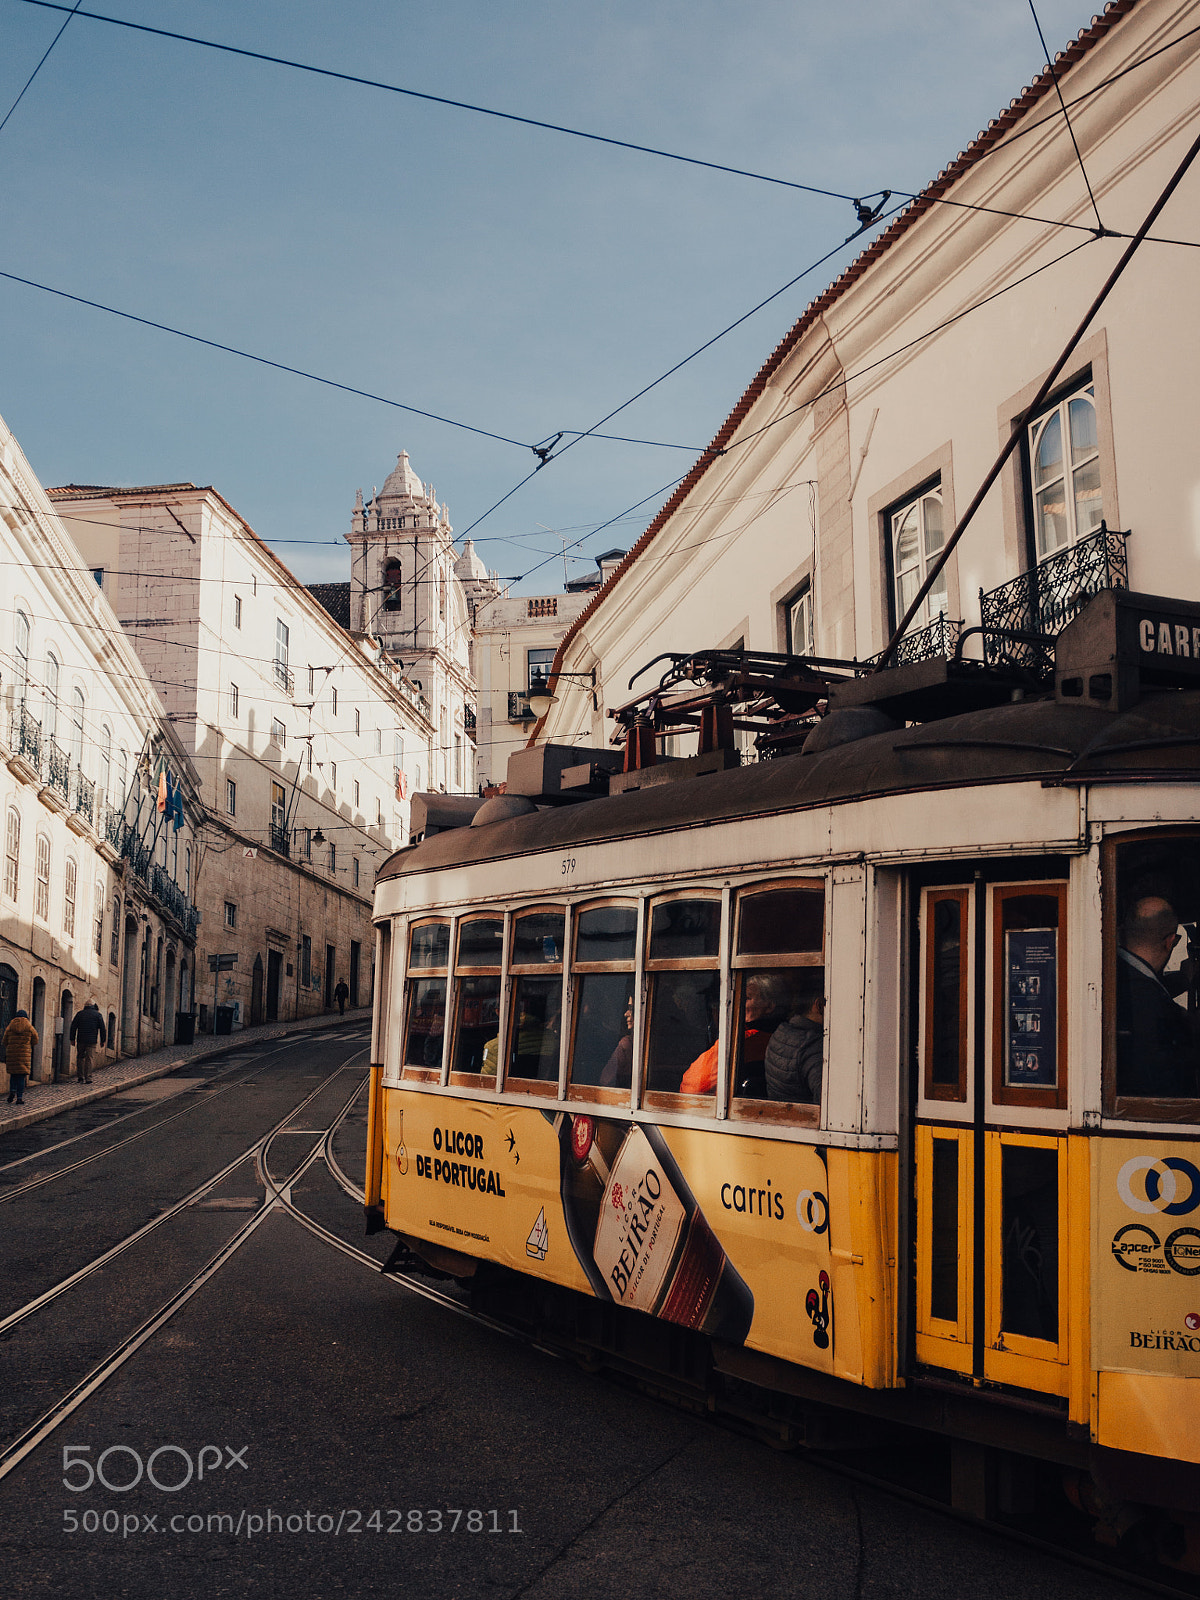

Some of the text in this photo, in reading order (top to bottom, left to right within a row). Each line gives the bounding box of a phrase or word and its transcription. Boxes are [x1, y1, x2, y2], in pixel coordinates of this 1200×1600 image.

[562, 858, 576, 875] 579
[433, 1127, 484, 1160] O LICOR
[416, 1154, 506, 1198] DE PORTUGAL
[618, 1188, 637, 1243] LICOR
[721, 1179, 784, 1220] carris
[610, 1169, 661, 1301] BEIRÃO
[632, 1265, 645, 1292] LICOR
[642, 1251, 650, 1265] DE
[648, 1204, 666, 1251] PORTUGAL
[1120, 1243, 1153, 1255] apcer
